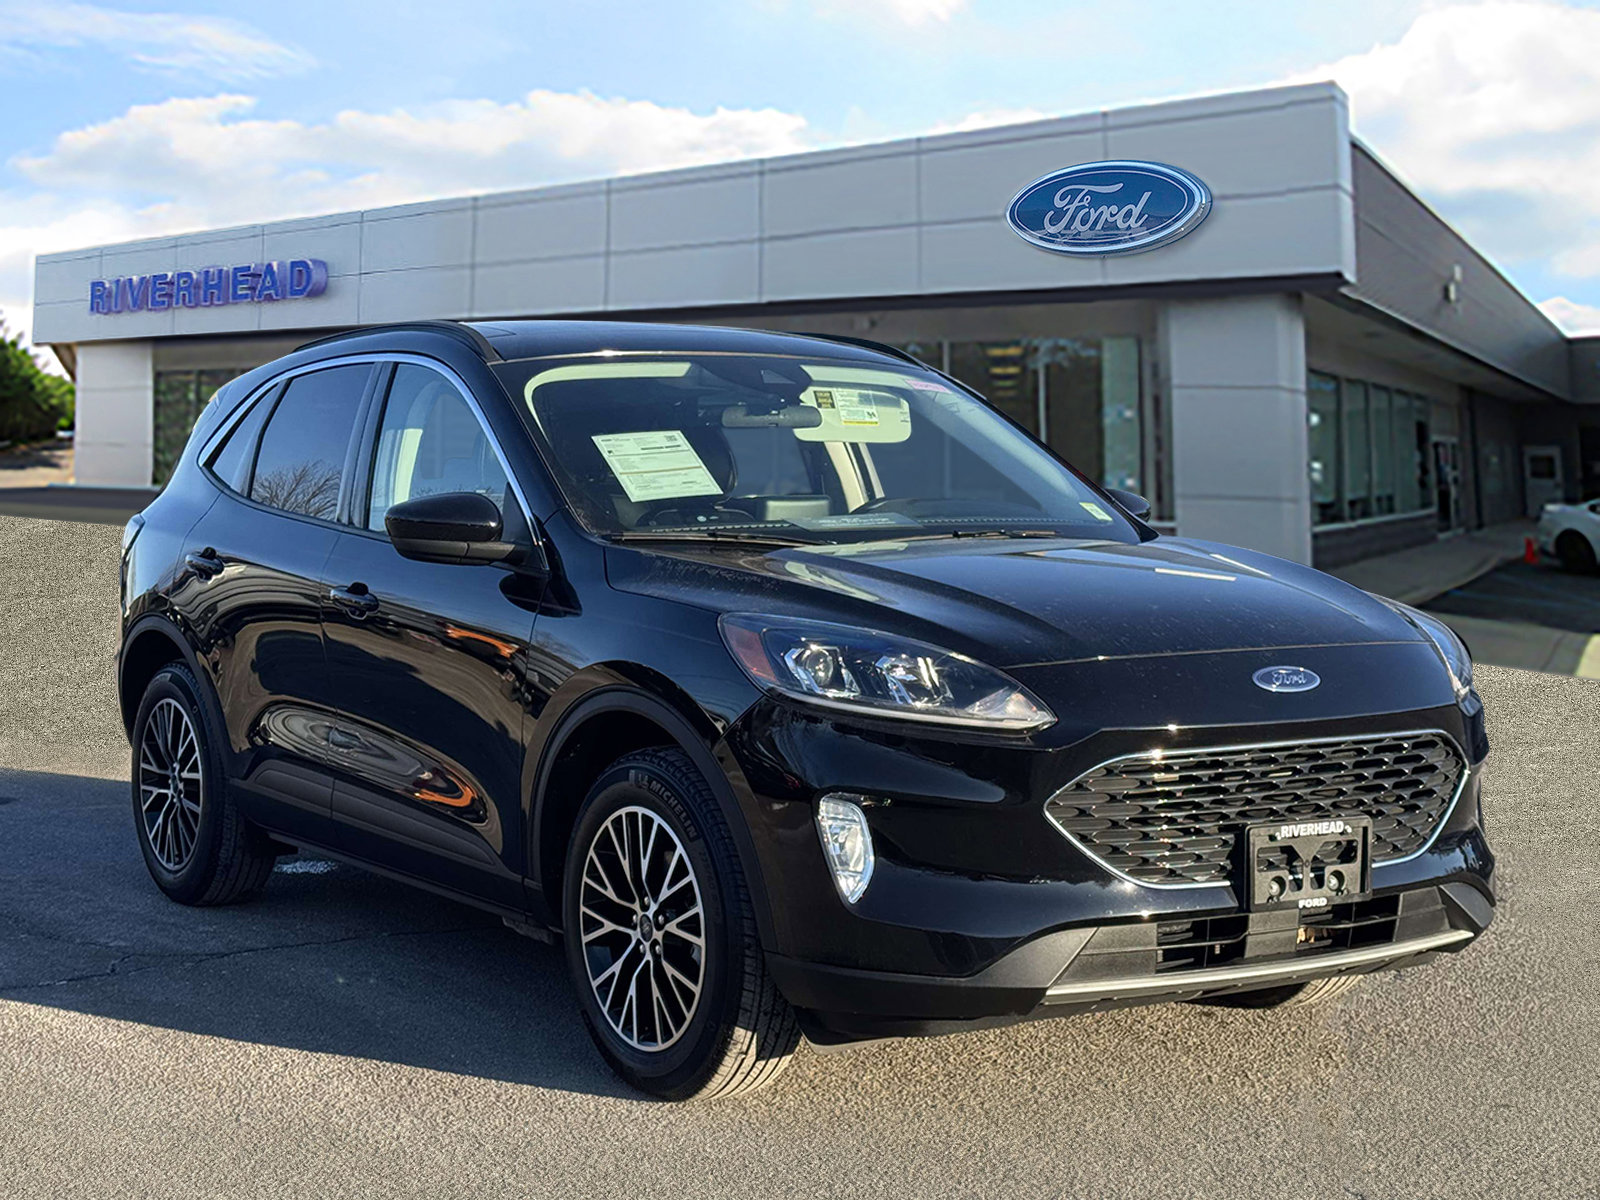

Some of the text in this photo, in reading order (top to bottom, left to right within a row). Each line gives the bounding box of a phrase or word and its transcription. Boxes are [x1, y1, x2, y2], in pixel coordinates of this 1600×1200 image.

[1043, 182, 1152, 234] Ford
[89, 258, 327, 316] RIVERHEAD
[1271, 669, 1307, 686] Ford
[650, 780, 699, 840] MICHELIN
[1280, 820, 1345, 839] RIVERHEAD
[1298, 897, 1328, 909] FORD
